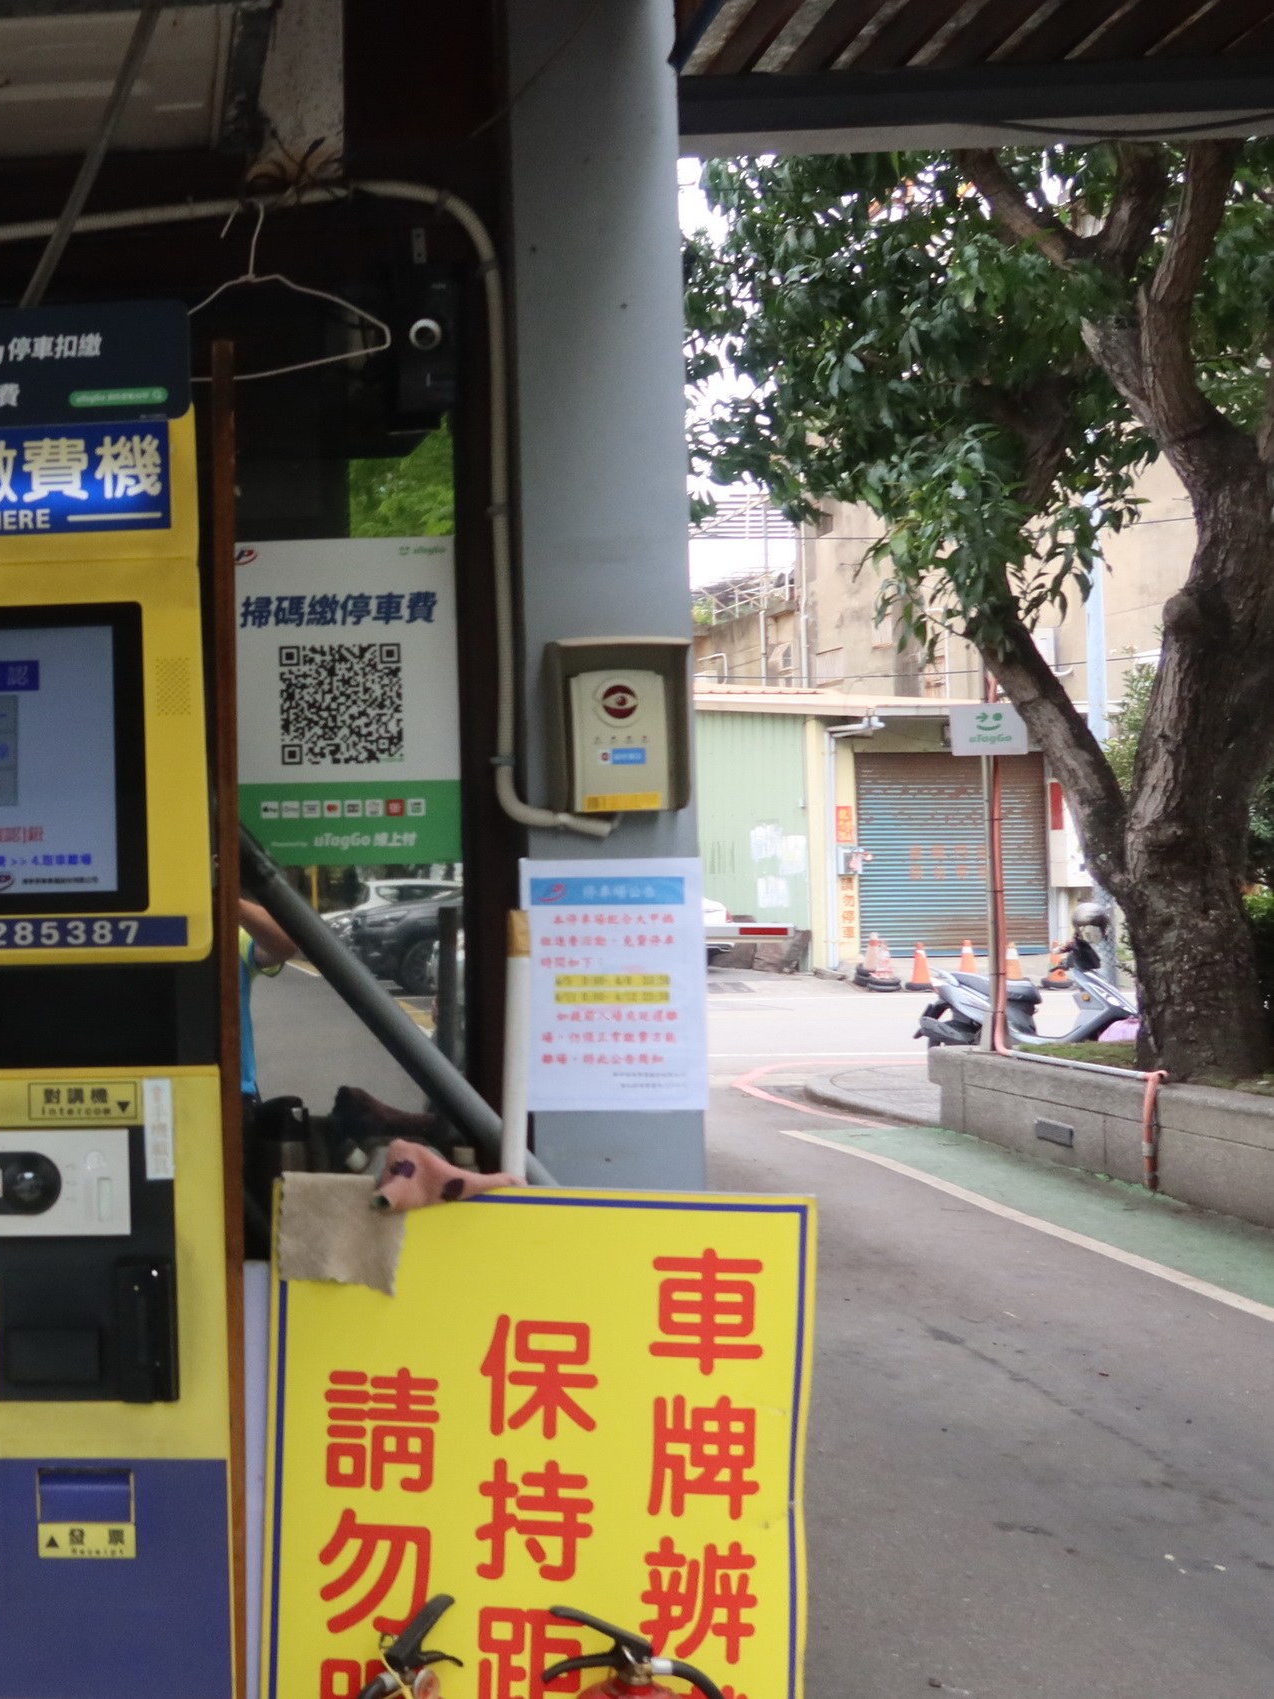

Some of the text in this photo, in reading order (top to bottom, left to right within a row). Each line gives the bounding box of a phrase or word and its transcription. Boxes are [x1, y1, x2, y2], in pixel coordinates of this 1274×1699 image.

[8, 332, 102, 362] 停車扣繳
[240, 590, 437, 629] 掃碼繳停車費
[969, 734, 1012, 744] uTagGo
[314, 832, 370, 850] uTagGo
[840, 877, 856, 939] 請勿停車
[44, 1088, 108, 1104] 對講機
[42, 1107, 111, 1116] Intercom
[640, 1248, 764, 1699] 車牌辨
